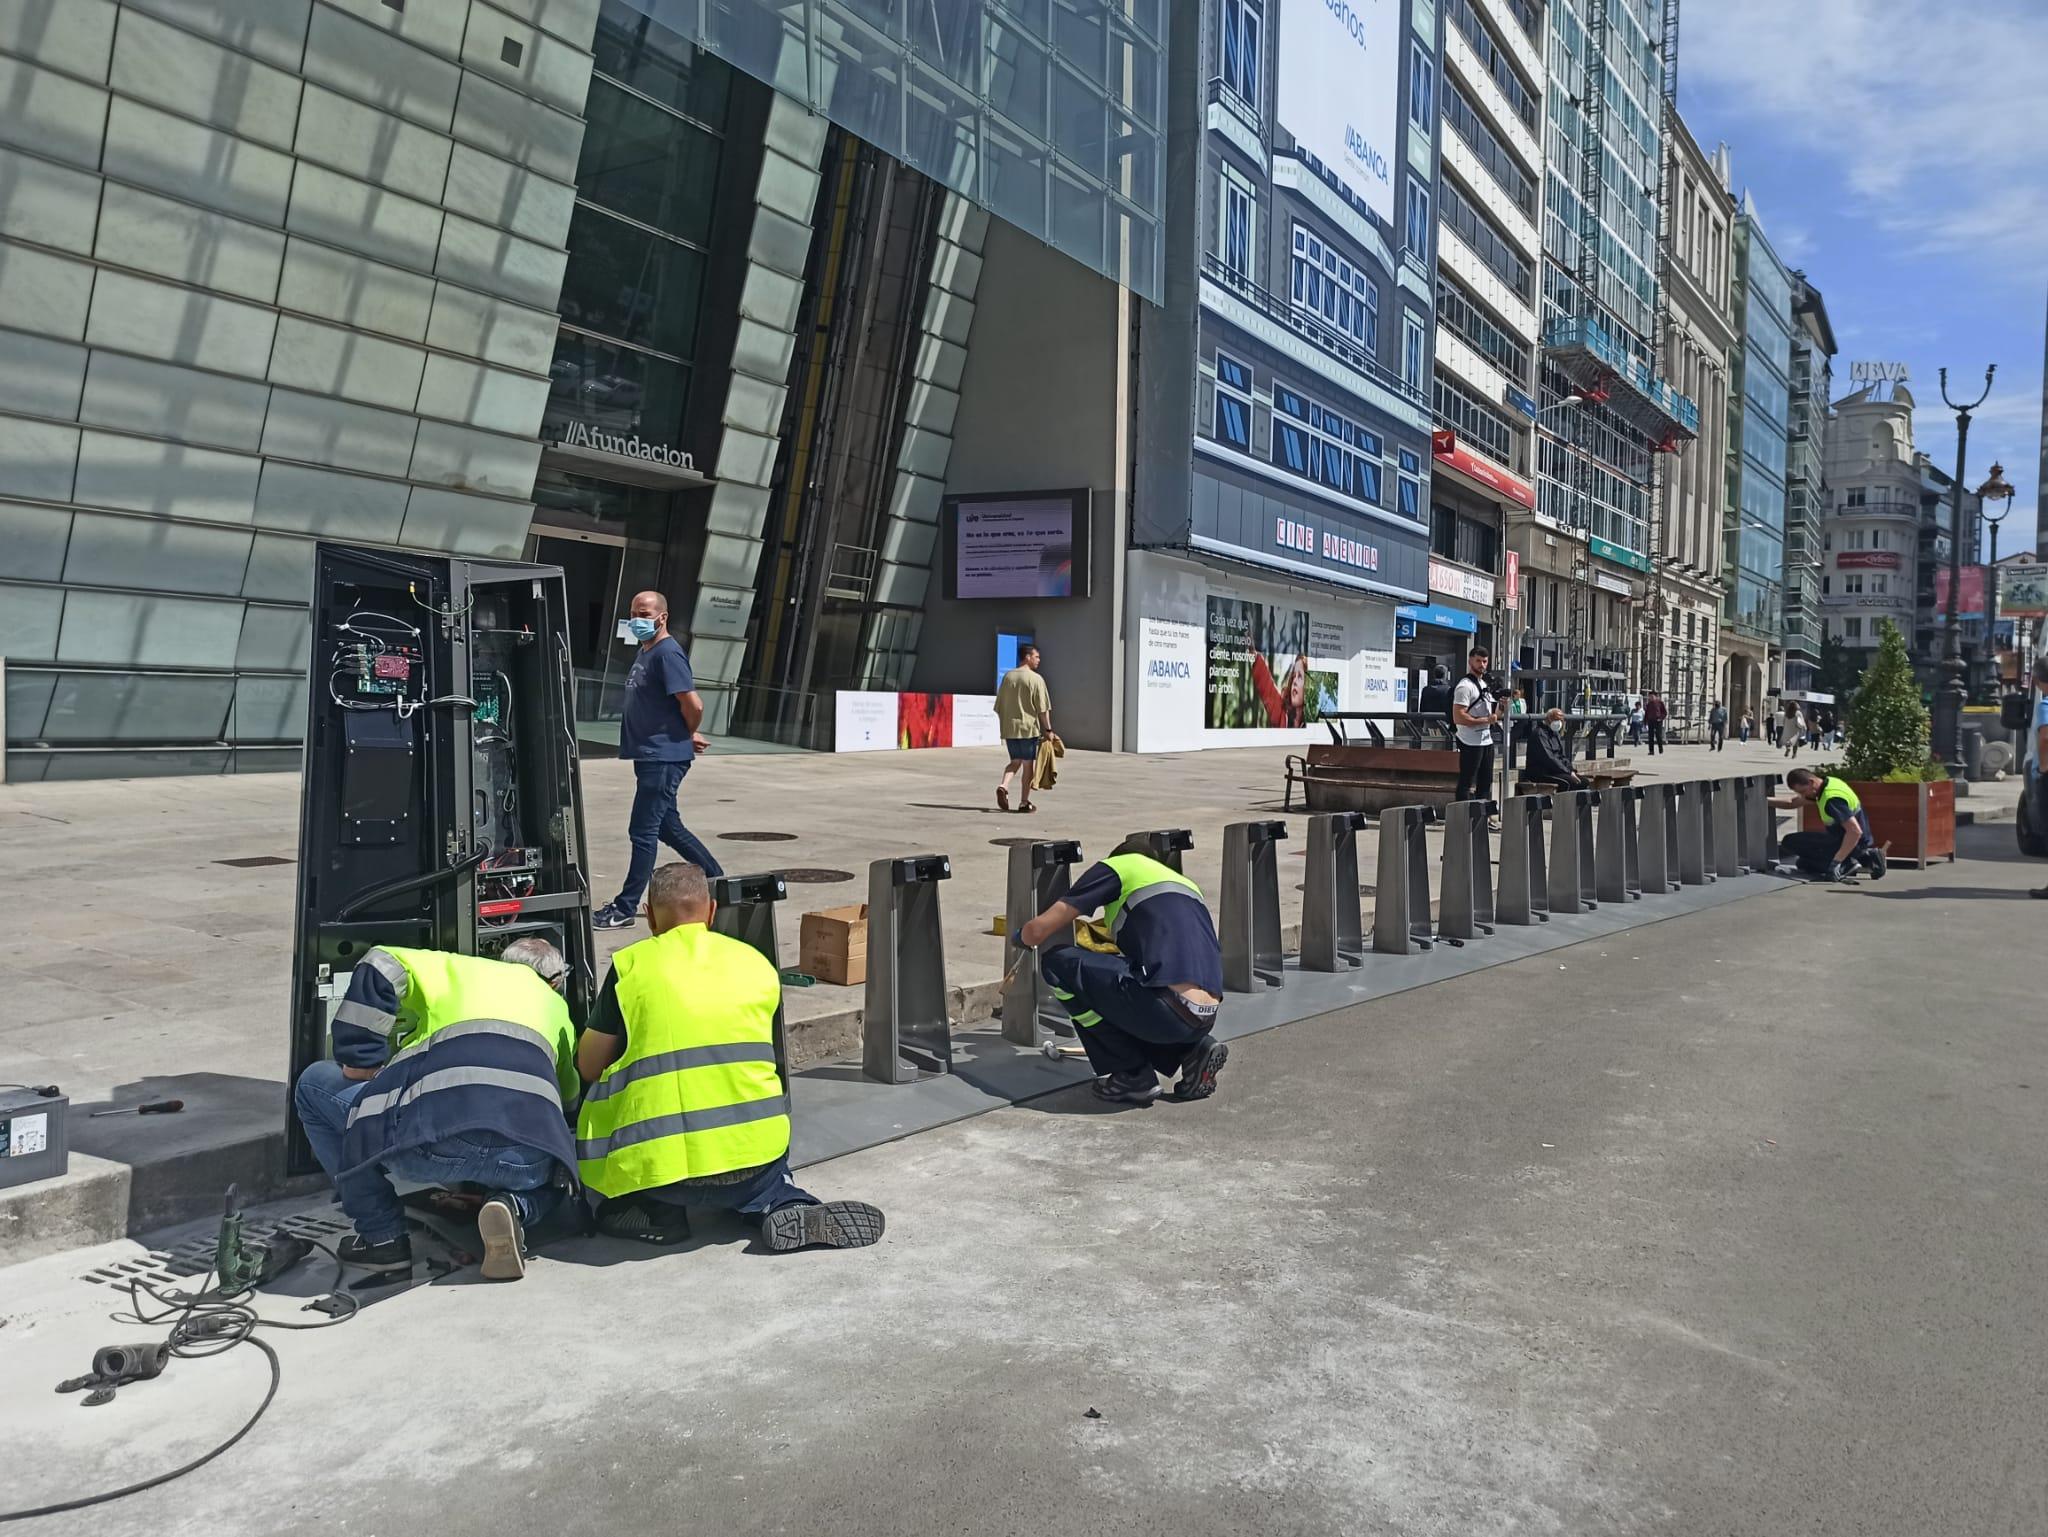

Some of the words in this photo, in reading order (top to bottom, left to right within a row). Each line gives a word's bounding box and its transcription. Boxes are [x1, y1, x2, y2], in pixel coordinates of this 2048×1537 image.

[1326, 0, 1367, 51] anos.
[1850, 361, 1910, 381] BBVA
[1277, 519, 1313, 552] CINE
[1323, 533, 1377, 570] AVENIDA
[1210, 612, 1226, 626] Cada
[1227, 618, 1236, 628] vez
[1238, 619, 1249, 630] que
[1210, 629, 1224, 643] llega
[1225, 635, 1233, 644] un
[1234, 635, 1251, 647] nuevo
[1209, 648, 1230, 661] cliente,
[1231, 649, 1256, 664] nosotros
[1209, 664, 1239, 678] plantamos
[1208, 683, 1217, 693] un
